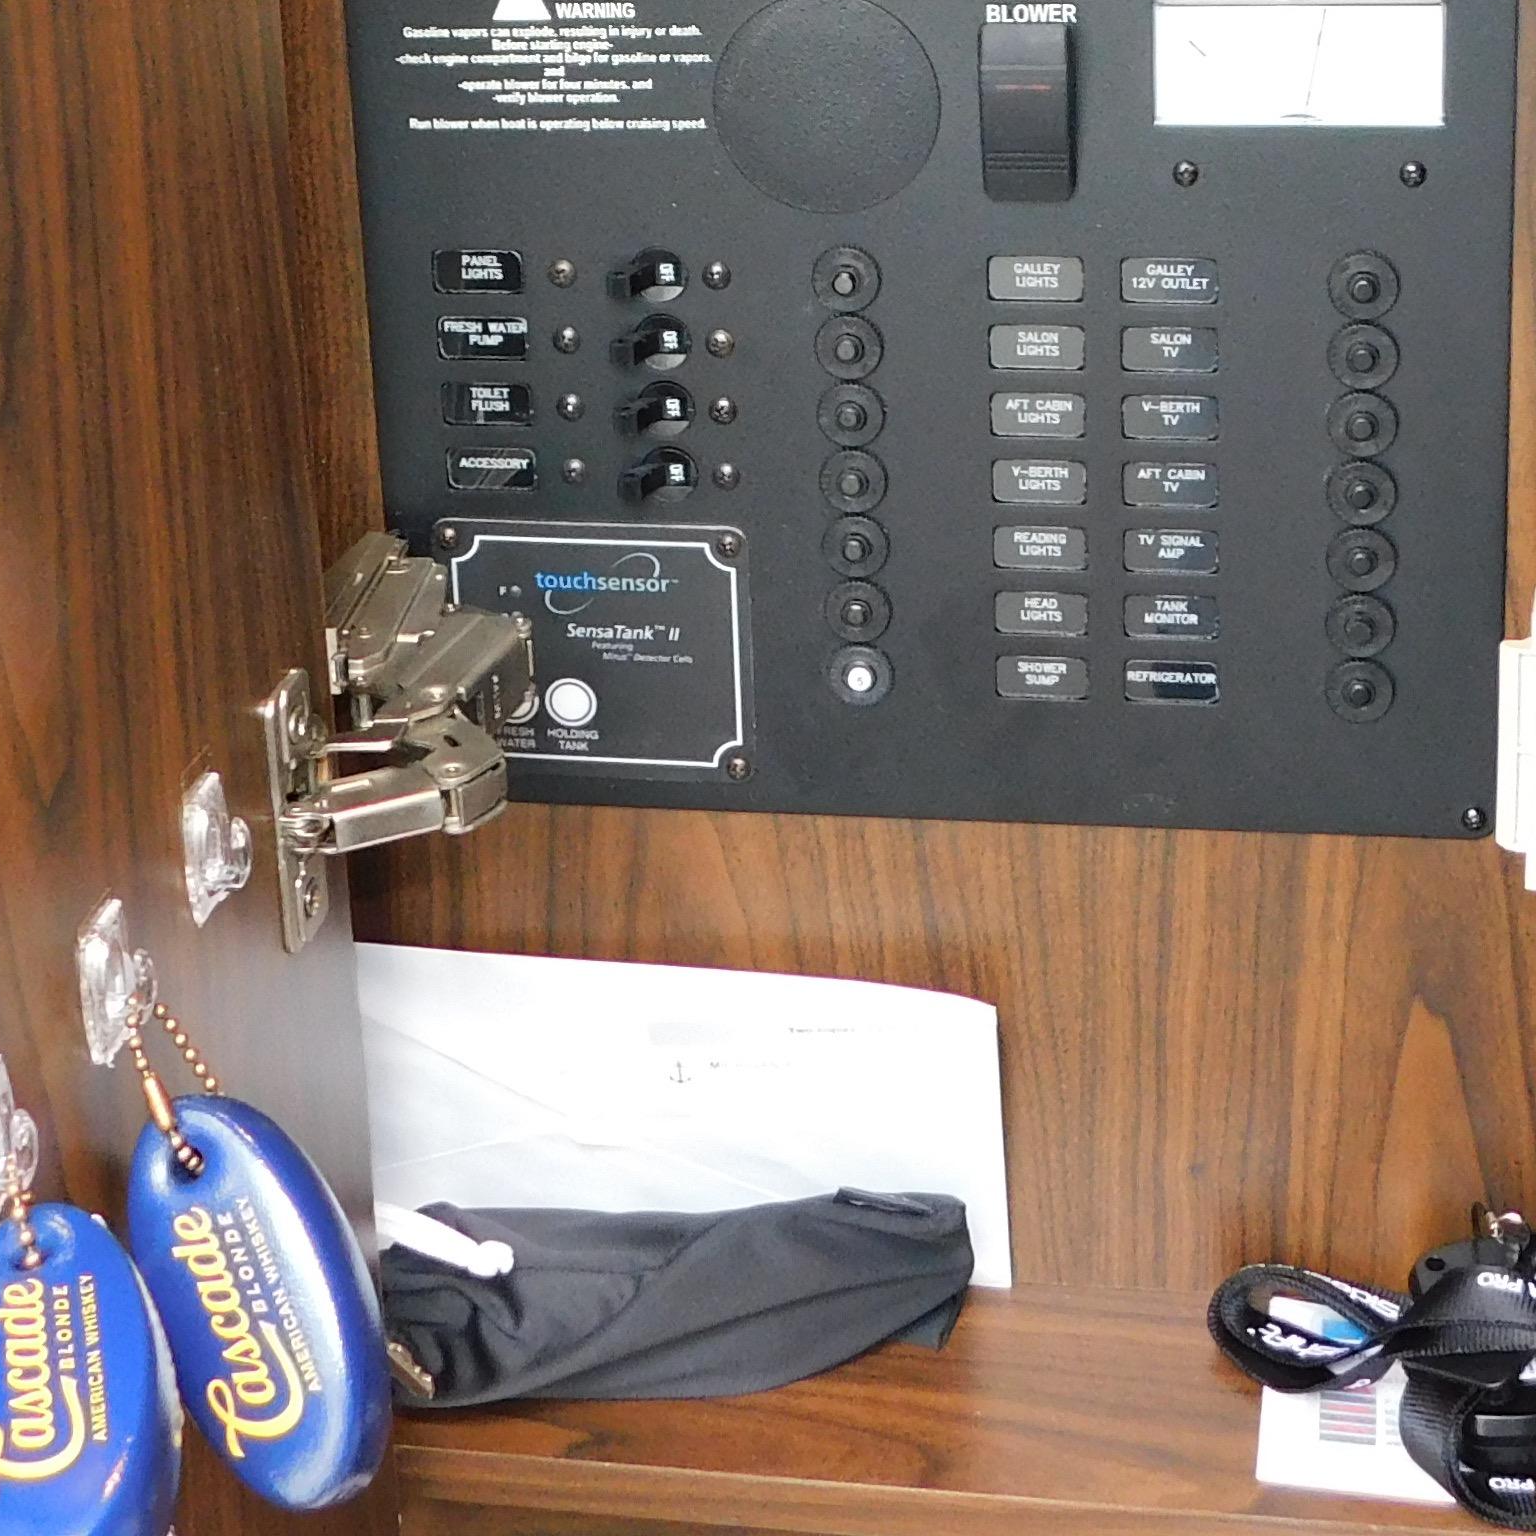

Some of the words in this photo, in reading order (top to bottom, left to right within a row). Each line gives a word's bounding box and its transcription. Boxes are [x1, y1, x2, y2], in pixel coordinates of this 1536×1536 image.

[556, 3, 635, 18] WARNING
[985, 3, 1077, 24] BLOWER
[491, 28, 510, 37] can
[559, 26, 607, 39] resulting
[609, 26, 619, 36] in
[621, 26, 652, 39] injury
[655, 28, 666, 36] or
[492, 40, 528, 51] Before
[433, 54, 468, 66] engine
[543, 53, 563, 63] and
[593, 52, 609, 63] for
[611, 53, 656, 65] gasoline
[659, 55, 670, 63] or
[544, 66, 565, 77] and
[504, 79, 540, 90] blower
[542, 79, 558, 90] for
[560, 79, 582, 90] four
[632, 78, 653, 89] and
[528, 92, 563, 103] blower
[409, 118, 431, 129] Run
[433, 118, 469, 129] blower
[471, 118, 499, 129] when
[502, 118, 525, 129] boat
[528, 118, 537, 129] is
[541, 118, 590, 132] operating
[592, 118, 624, 129] below
[626, 118, 670, 131] cruising
[461, 255, 502, 267] PANEL
[461, 268, 504, 280] LIGHTS
[1014, 263, 1060, 274] GALLEY
[1146, 265, 1194, 276] GALLEY
[1016, 276, 1058, 288] LIGHTS
[1132, 278, 1156, 289] 12V
[1162, 278, 1210, 290] OUTLET
[443, 321, 482, 333] FRESH
[488, 322, 528, 333] WATER
[469, 334, 504, 345] PUMP
[1017, 332, 1058, 343] SALON
[1150, 333, 1191, 345] SALON
[1017, 346, 1060, 357] LIGHTS
[1163, 347, 1179, 357] TV
[470, 388, 510, 399] TOILET
[471, 400, 510, 411] FLUSH
[1006, 400, 1029, 410] AFT
[1036, 400, 1072, 411] CABIN
[1142, 401, 1200, 413] V-BERTH
[1018, 413, 1060, 424] LIGHTS
[1163, 415, 1179, 425] TV
[459, 457, 529, 469] ACCESSORY
[1013, 467, 1068, 478] V-BERTH
[1137, 469, 1161, 480] AFT
[1168, 469, 1205, 480] CABIN
[1019, 480, 1061, 491] LIGHTS
[1163, 482, 1179, 492] TV
[1014, 532, 1066, 543] READING
[1138, 535, 1154, 545] TV
[1160, 535, 1204, 547] SIGNAL
[1019, 545, 1061, 557] LIGHTS
[1158, 548, 1184, 558] AMP
[1024, 598, 1057, 609] HEAD
[1155, 601, 1187, 611] TANK
[1021, 610, 1062, 621] LIGHTS
[1145, 613, 1198, 625] MONITOR
[1018, 663, 1067, 673] SHOWER
[1025, 675, 1059, 685] SUMP
[1127, 671, 1216, 685] REFRIGERATOR
[547, 728, 599, 741] HOLDING
[559, 740, 589, 752] TANK
[235, 1197, 279, 1287] WHISKEY
[217, 1211, 272, 1313] BLONDE
[78, 1273, 102, 1349] WHISKEY
[51, 1285, 75, 1371] BLONDE
[172, 1206, 305, 1458] Cascade
[272, 1287, 323, 1391] AMERICAN
[83, 1348, 108, 1442] AMERICAN
[1488, 1477, 1534, 1493] PRO
